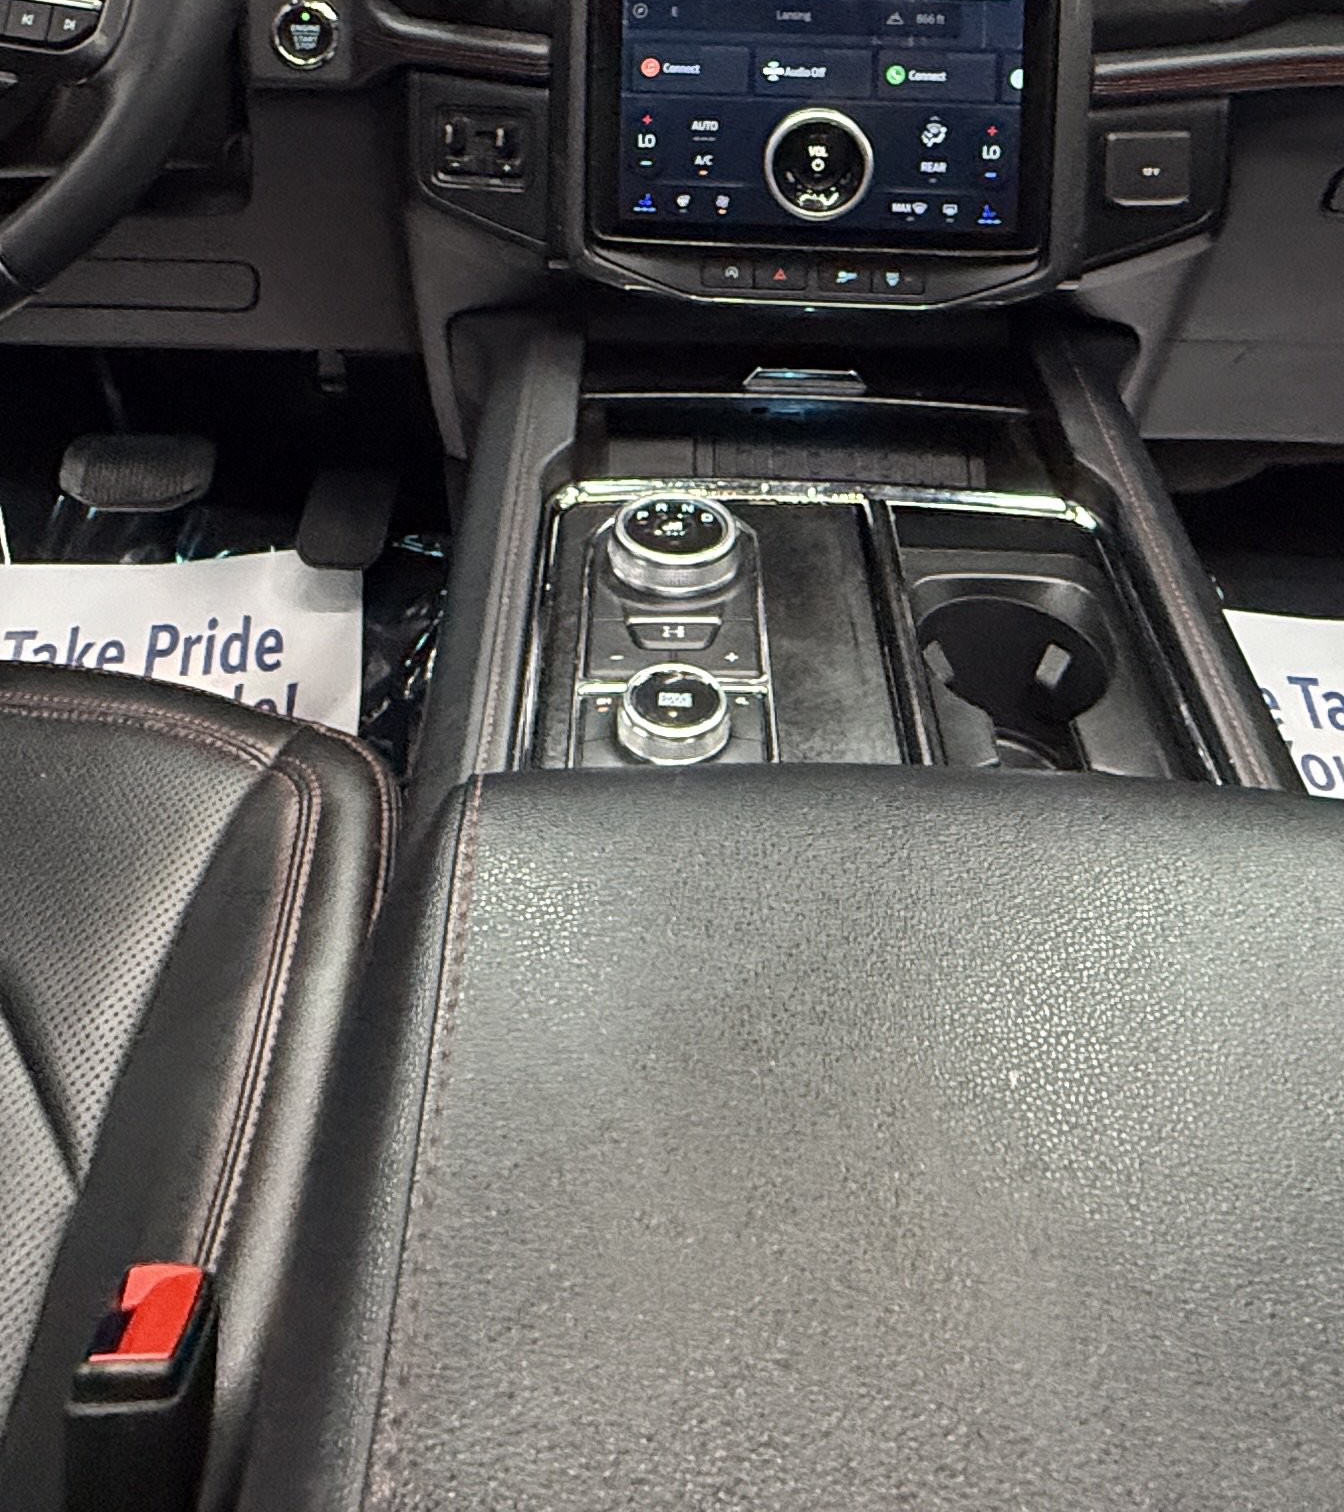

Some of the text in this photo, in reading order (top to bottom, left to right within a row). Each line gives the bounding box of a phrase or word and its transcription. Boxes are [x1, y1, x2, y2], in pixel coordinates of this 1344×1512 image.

[775, 10, 811, 23] Lansing
[663, 62, 701, 75] Connect
[784, 66, 810, 78] Audio
[908, 69, 947, 82] Connect
[691, 120, 719, 131] AUTO
[638, 133, 656, 148] LO
[808, 145, 829, 158] VOL
[982, 144, 1001, 160] LO
[694, 154, 714, 166] A/C
[920, 161, 948, 173] REAR
[891, 202, 912, 213] MAX
[656, 502, 668, 513] R
[681, 503, 695, 514] N
[637, 510, 649, 521] P
[701, 512, 714, 523] D
[144, 615, 284, 678] Pride
